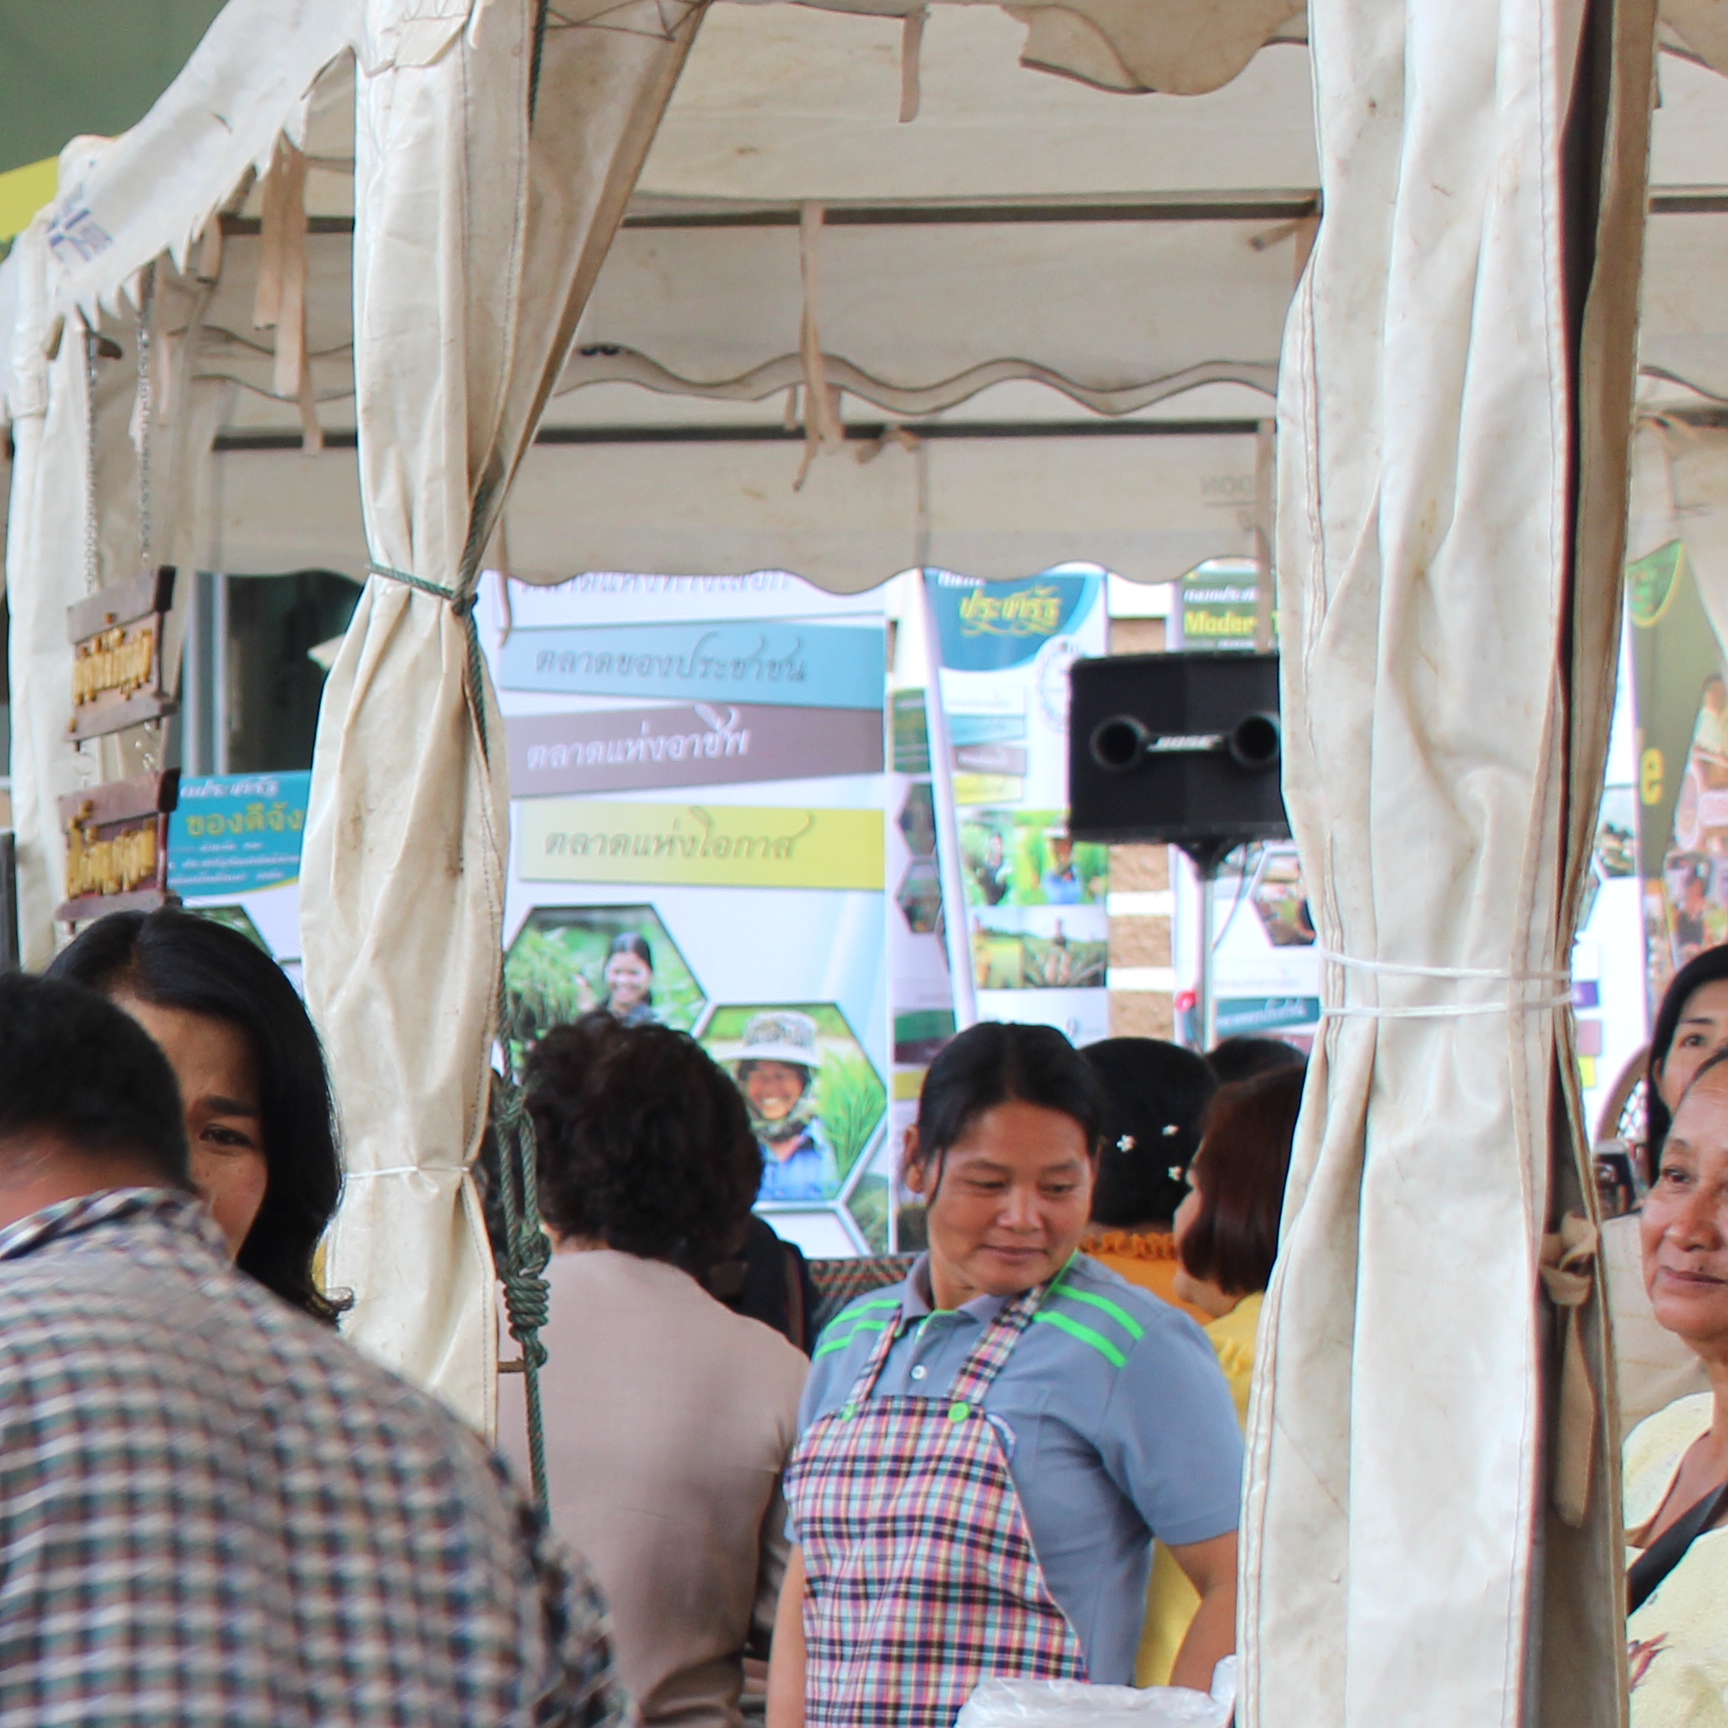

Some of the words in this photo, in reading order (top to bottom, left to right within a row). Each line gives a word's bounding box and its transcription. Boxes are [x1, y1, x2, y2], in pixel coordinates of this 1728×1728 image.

[1184, 611, 1258, 635] Moder
[534, 632, 806, 682] ตลาดของประชาชน
[526, 704, 750, 770] ตลาดแห่งอาชีพ
[545, 806, 815, 861] ตลาดแห่งโอกาส
